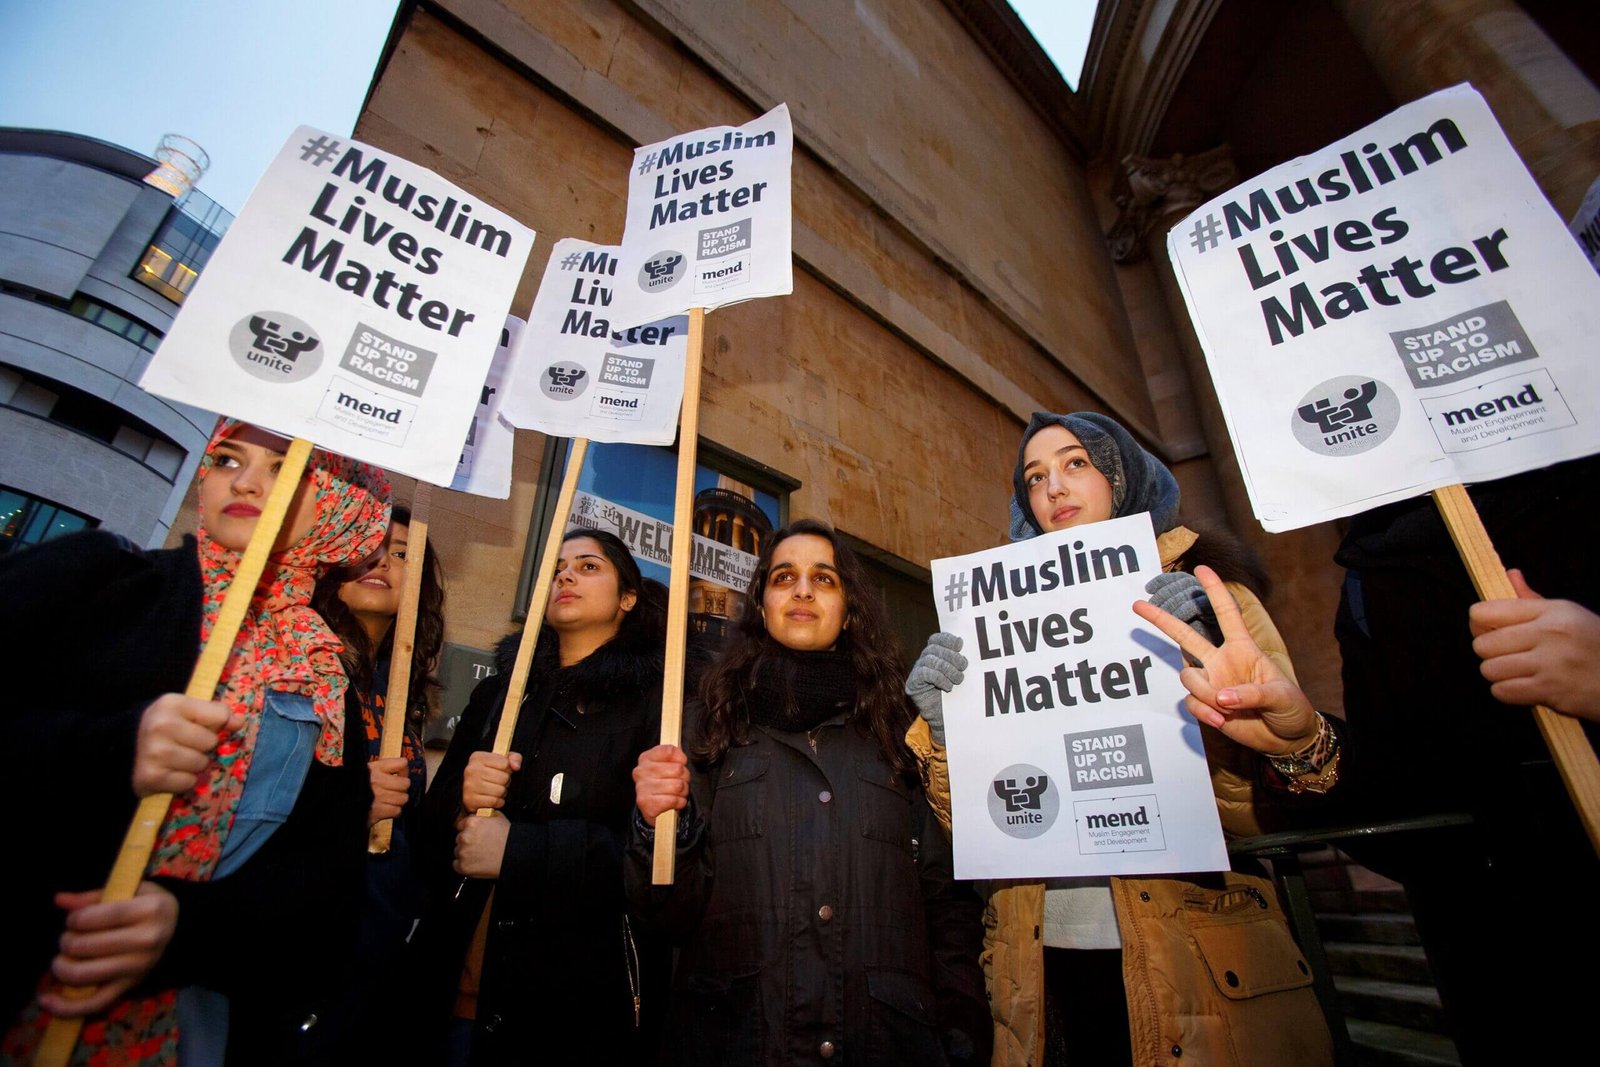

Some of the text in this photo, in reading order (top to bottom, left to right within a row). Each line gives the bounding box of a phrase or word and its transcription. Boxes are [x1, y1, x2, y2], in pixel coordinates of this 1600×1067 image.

[638, 131, 776, 175] #Muslim
[654, 160, 734, 199] Lives
[1188, 118, 1467, 253] #Muslim
[300, 135, 512, 258] #Muslim
[649, 182, 767, 230] Matter
[309, 182, 443, 275] Lives
[702, 226, 740, 240] STAND
[702, 234, 737, 248] UP TO
[702, 238, 746, 256] RACISM
[1237, 206, 1410, 291] Lives
[282, 226, 475, 337] Matter
[648, 276, 674, 287] unite
[702, 261, 743, 280] mend
[570, 278, 613, 306] Liv
[1260, 227, 1510, 346] Matter
[560, 309, 676, 346] Mater
[1403, 316, 1486, 350] STAND
[355, 343, 409, 373] UP TO
[360, 331, 417, 362] STAND
[1410, 333, 1489, 363] UP TO
[1417, 340, 1522, 380] RACISM
[246, 350, 293, 374] unite
[349, 355, 420, 389] RACISM
[606, 365, 639, 376] UP TO
[607, 357, 643, 369] STAND
[549, 385, 574, 395] unite
[604, 372, 647, 385] RACISM
[337, 392, 402, 424] mend
[600, 396, 639, 408] mend
[1442, 383, 1543, 426] mend
[1324, 423, 1378, 446] unite
[1450, 406, 1547, 436] Muslim Engagement
[1460, 416, 1545, 443] and Development
[944, 540, 1140, 613] #Muslim
[974, 607, 1094, 661] Lives
[984, 656, 1152, 718] Matter
[1072, 734, 1127, 752] STAND
[1074, 750, 1126, 768] UP TO
[1076, 764, 1144, 783] RACISM
[1006, 811, 1043, 825] unite
[1085, 806, 1150, 829] mend
[1110, 828, 1150, 838] Engagement
